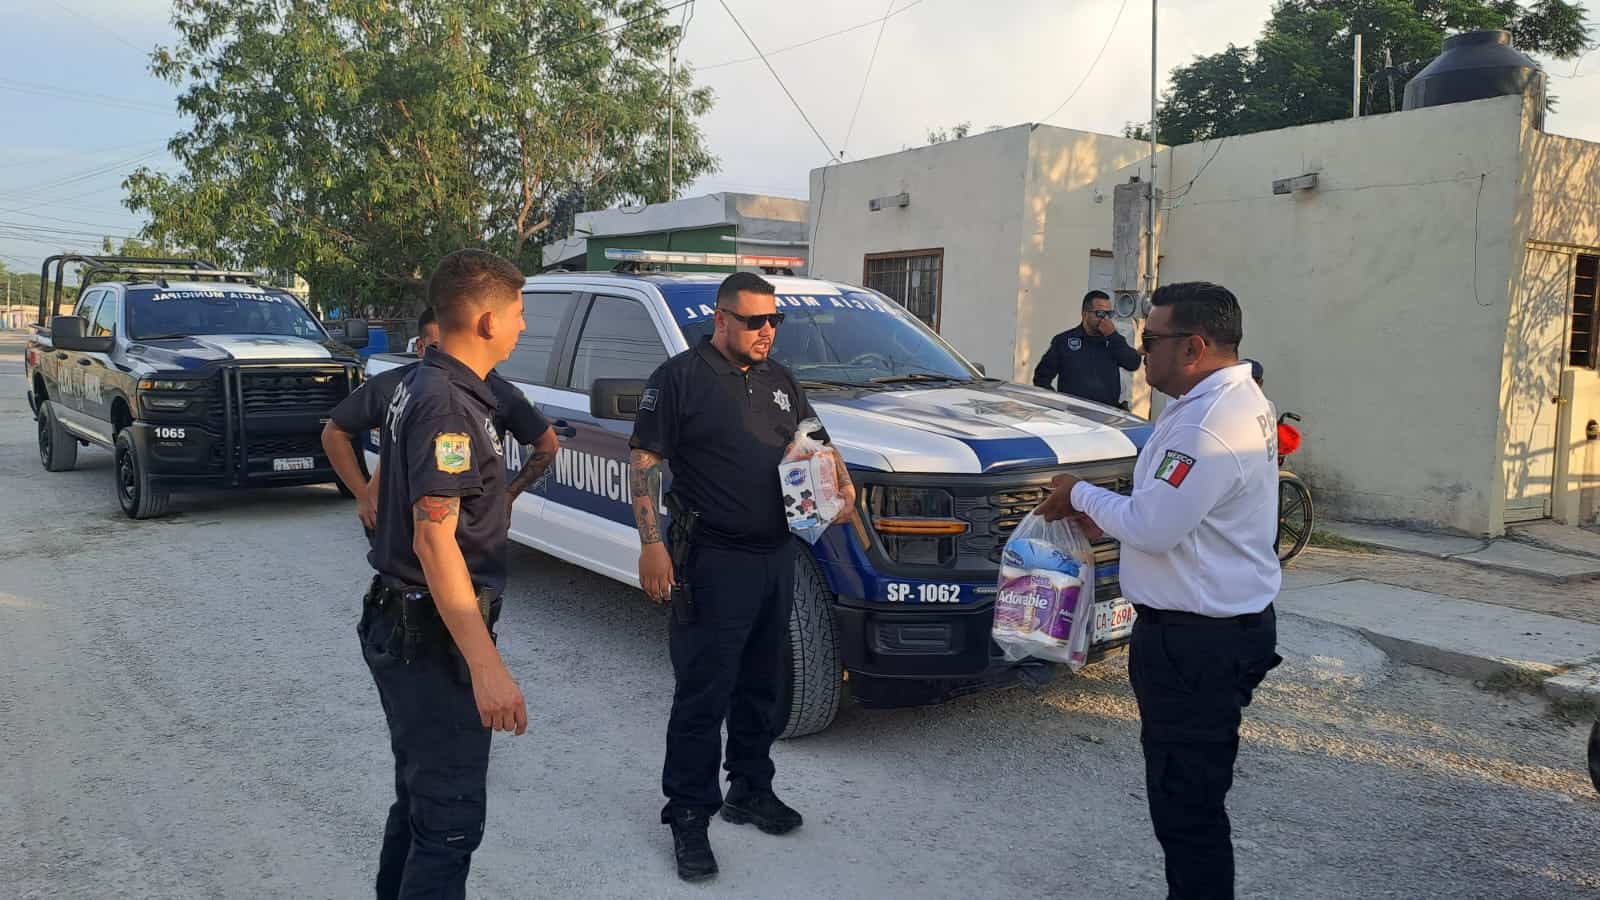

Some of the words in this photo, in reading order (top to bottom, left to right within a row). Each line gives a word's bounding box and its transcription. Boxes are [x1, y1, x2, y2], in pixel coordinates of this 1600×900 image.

[154, 427, 185, 439] 1065
[555, 447, 667, 515] MUNICIL
[999, 590, 1049, 610] Adorable
